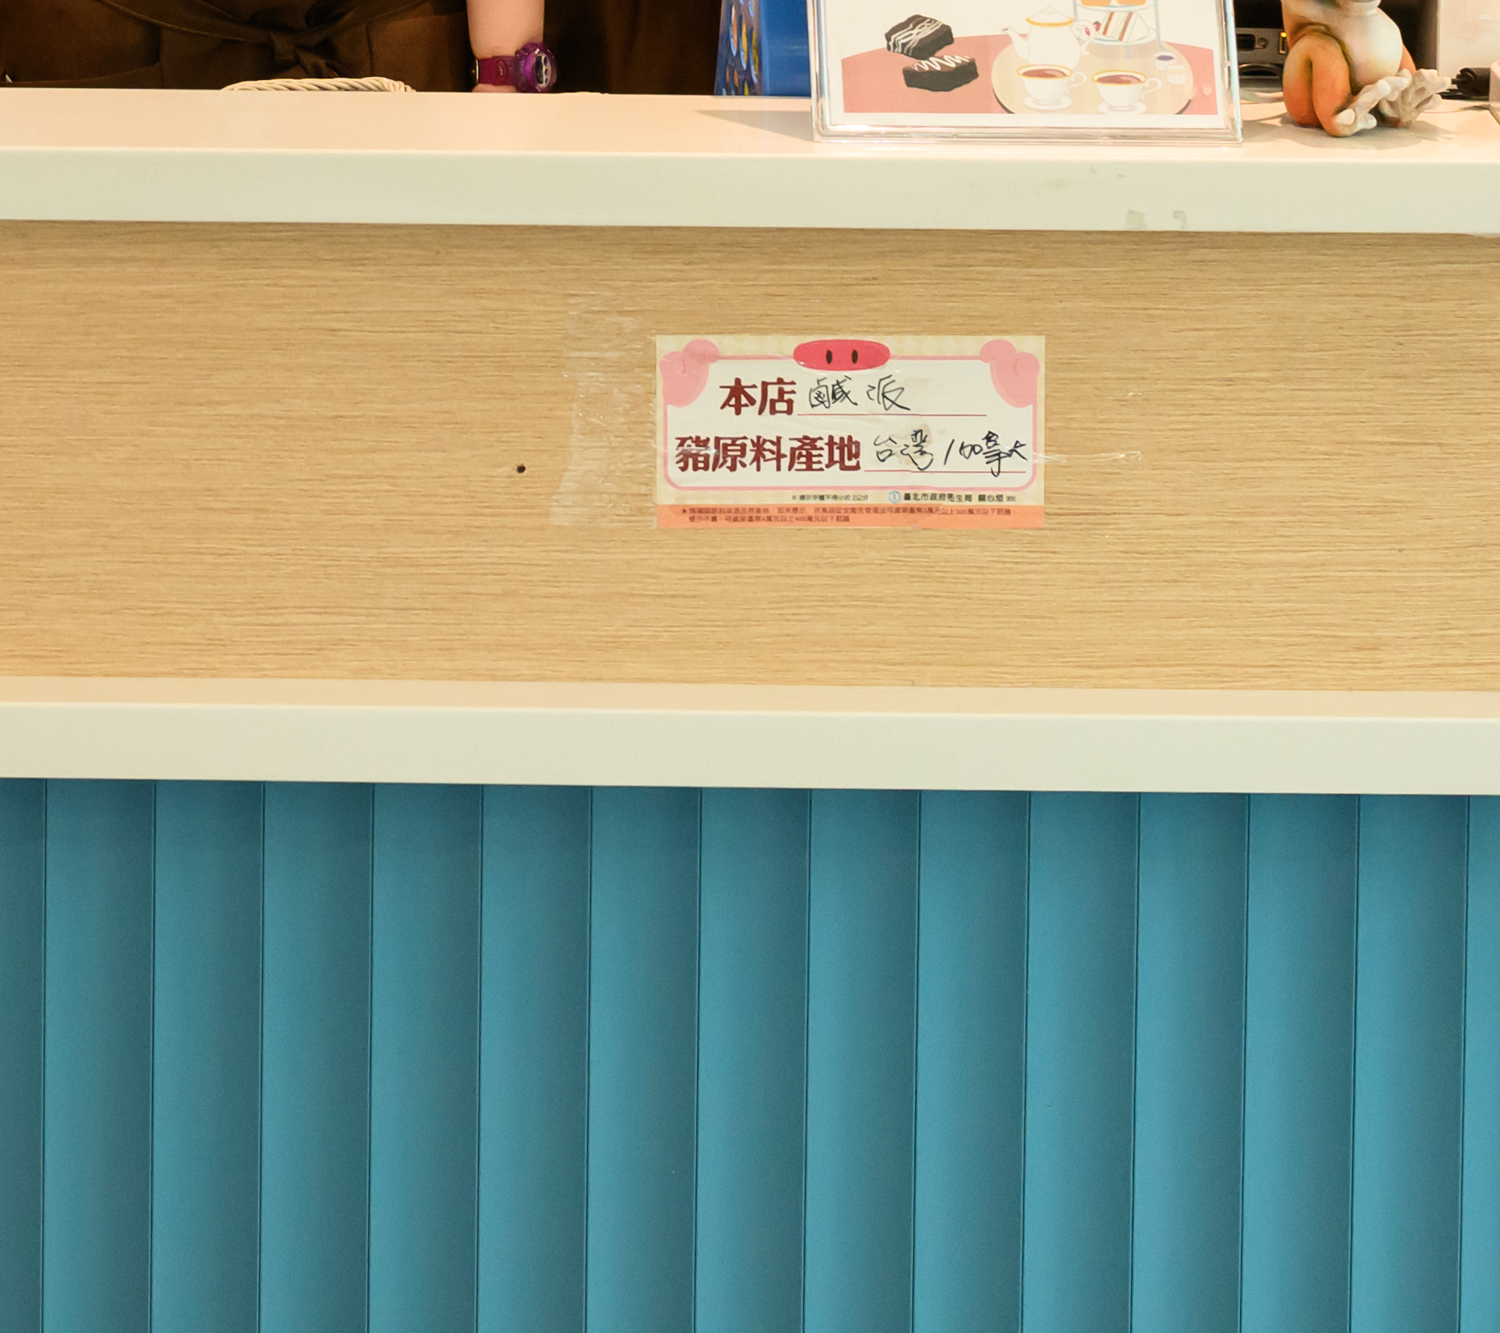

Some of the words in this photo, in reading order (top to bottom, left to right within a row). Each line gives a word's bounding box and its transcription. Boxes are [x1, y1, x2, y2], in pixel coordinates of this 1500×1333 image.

[719, 378, 797, 416] 本店
[674, 435, 861, 473] 豬原料產地
